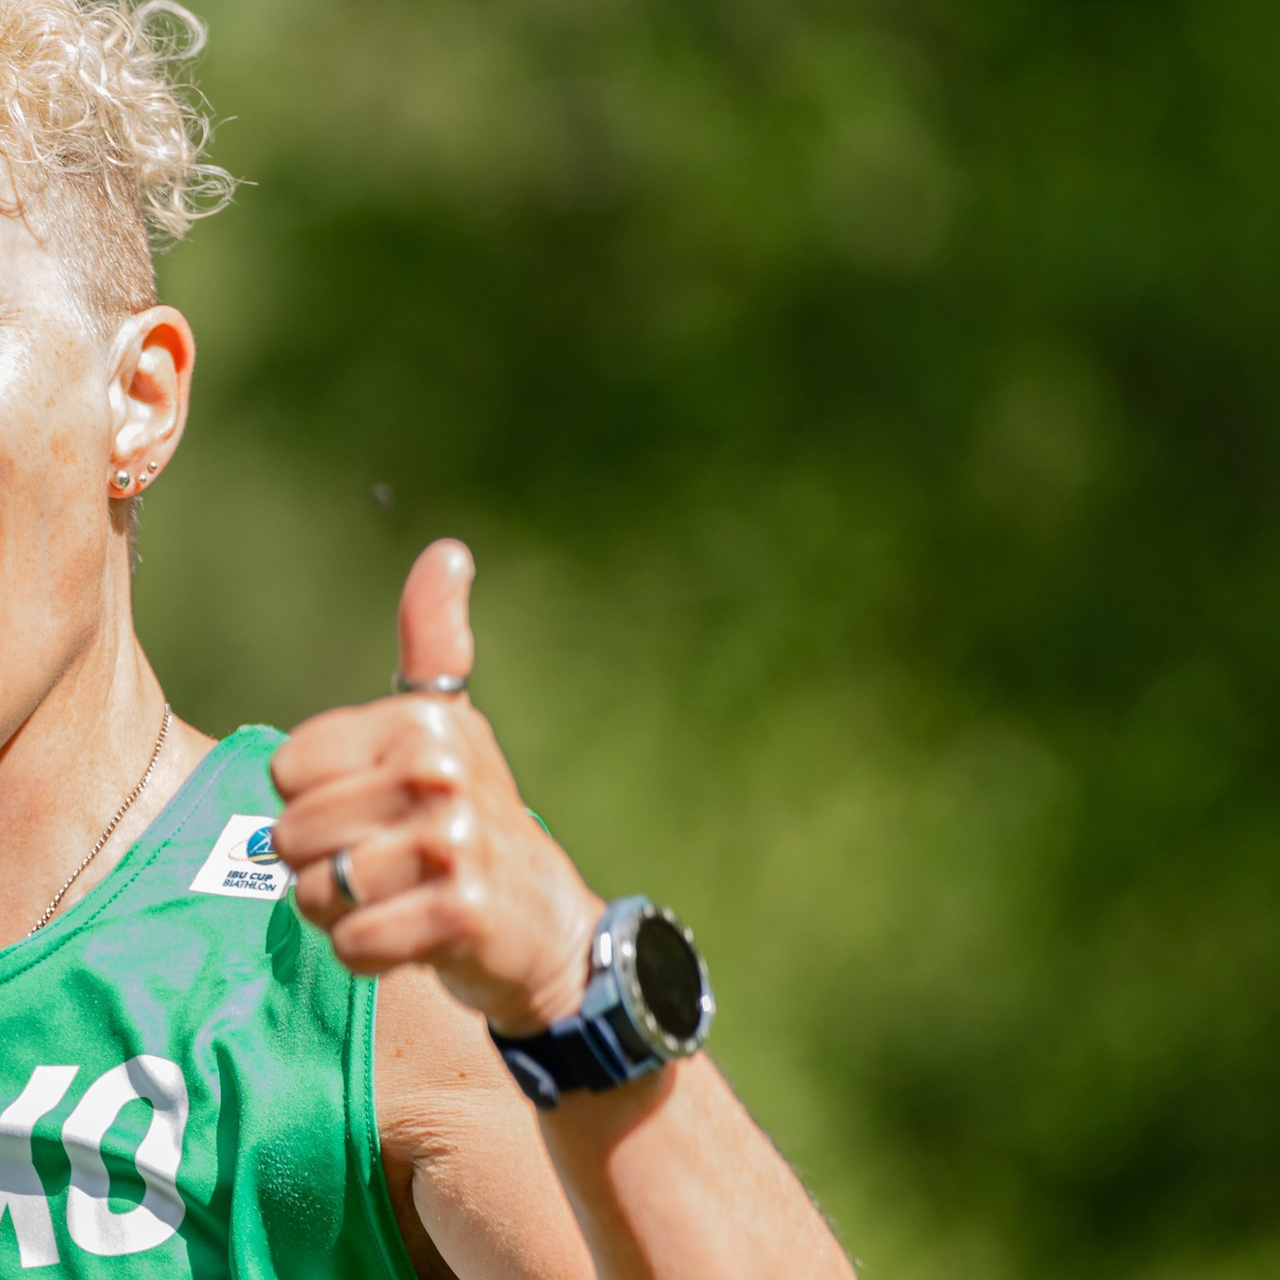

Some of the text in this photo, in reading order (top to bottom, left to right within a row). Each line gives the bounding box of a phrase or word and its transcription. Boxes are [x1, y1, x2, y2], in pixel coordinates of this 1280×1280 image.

[227, 870, 273, 881] IBU CUP
[222, 879, 276, 891] BIATHLON
